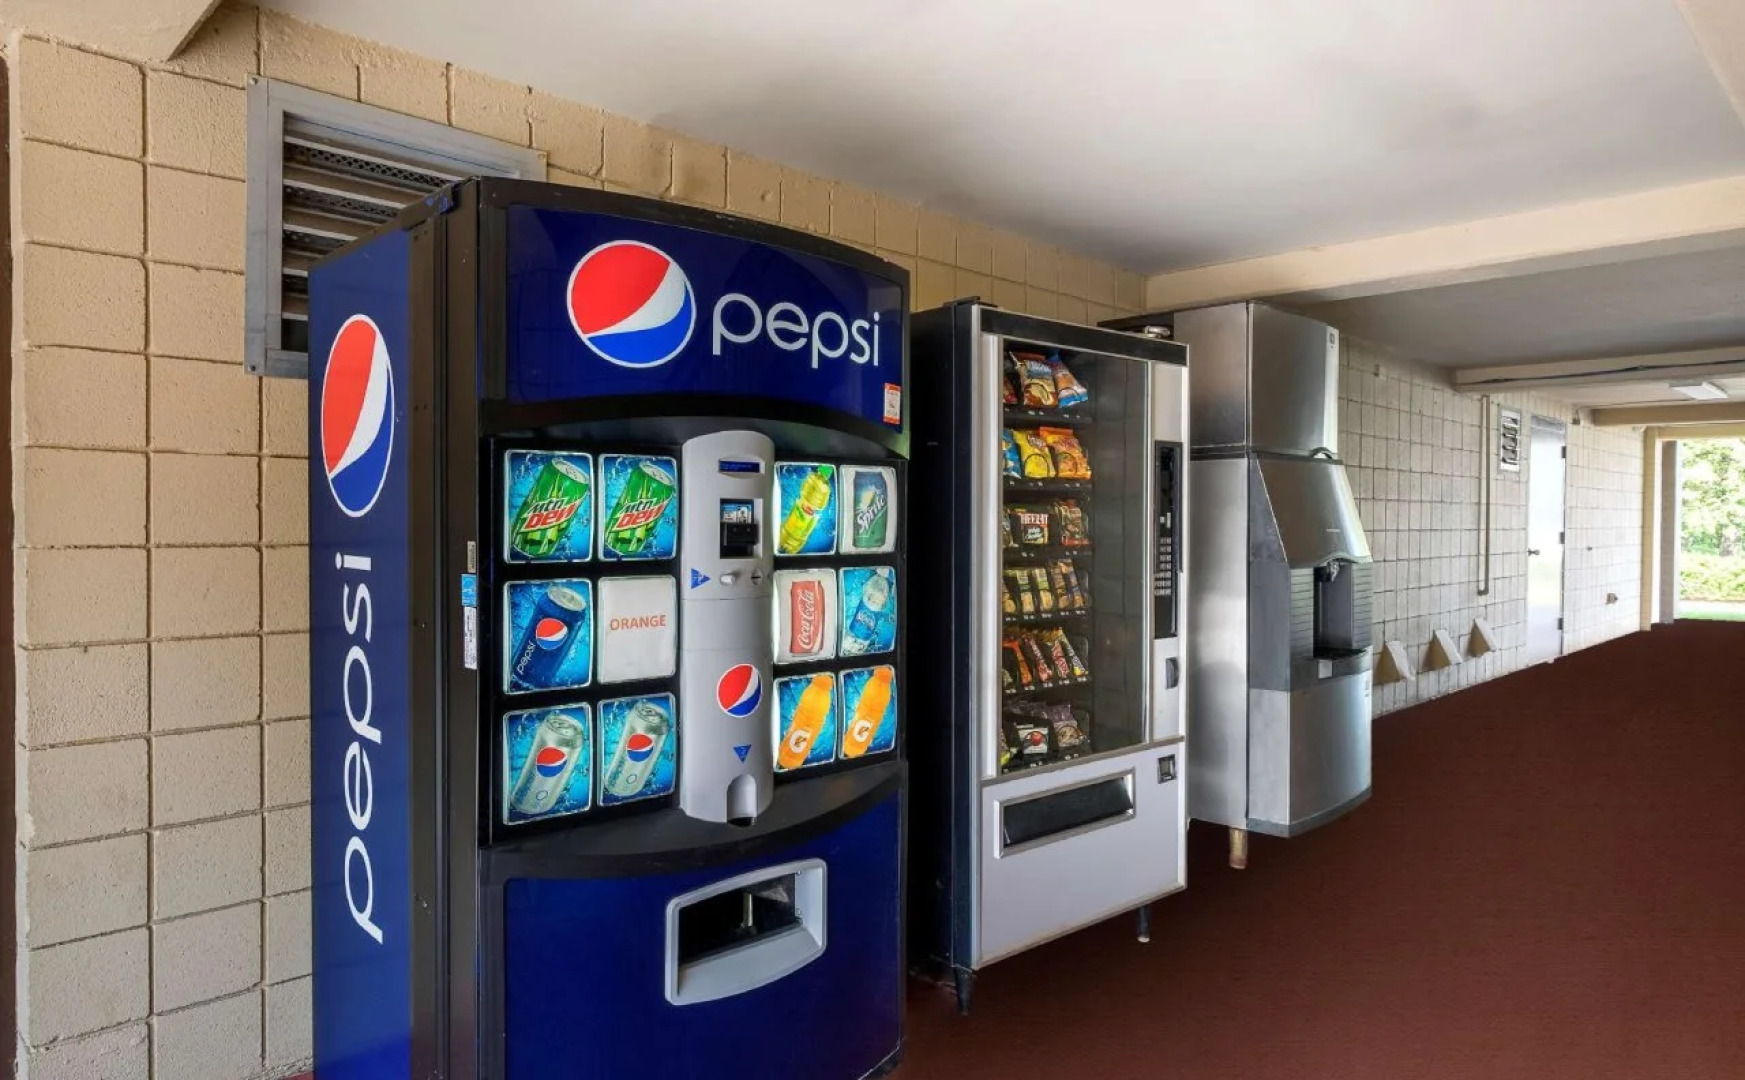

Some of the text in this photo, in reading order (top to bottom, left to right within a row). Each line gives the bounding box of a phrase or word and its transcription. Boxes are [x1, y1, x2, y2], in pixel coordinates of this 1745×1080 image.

[712, 292, 880, 369] pepsi
[610, 614, 666, 631] ORANGE
[517, 640, 537, 675] pepsi
[335, 551, 383, 944] pepsi
